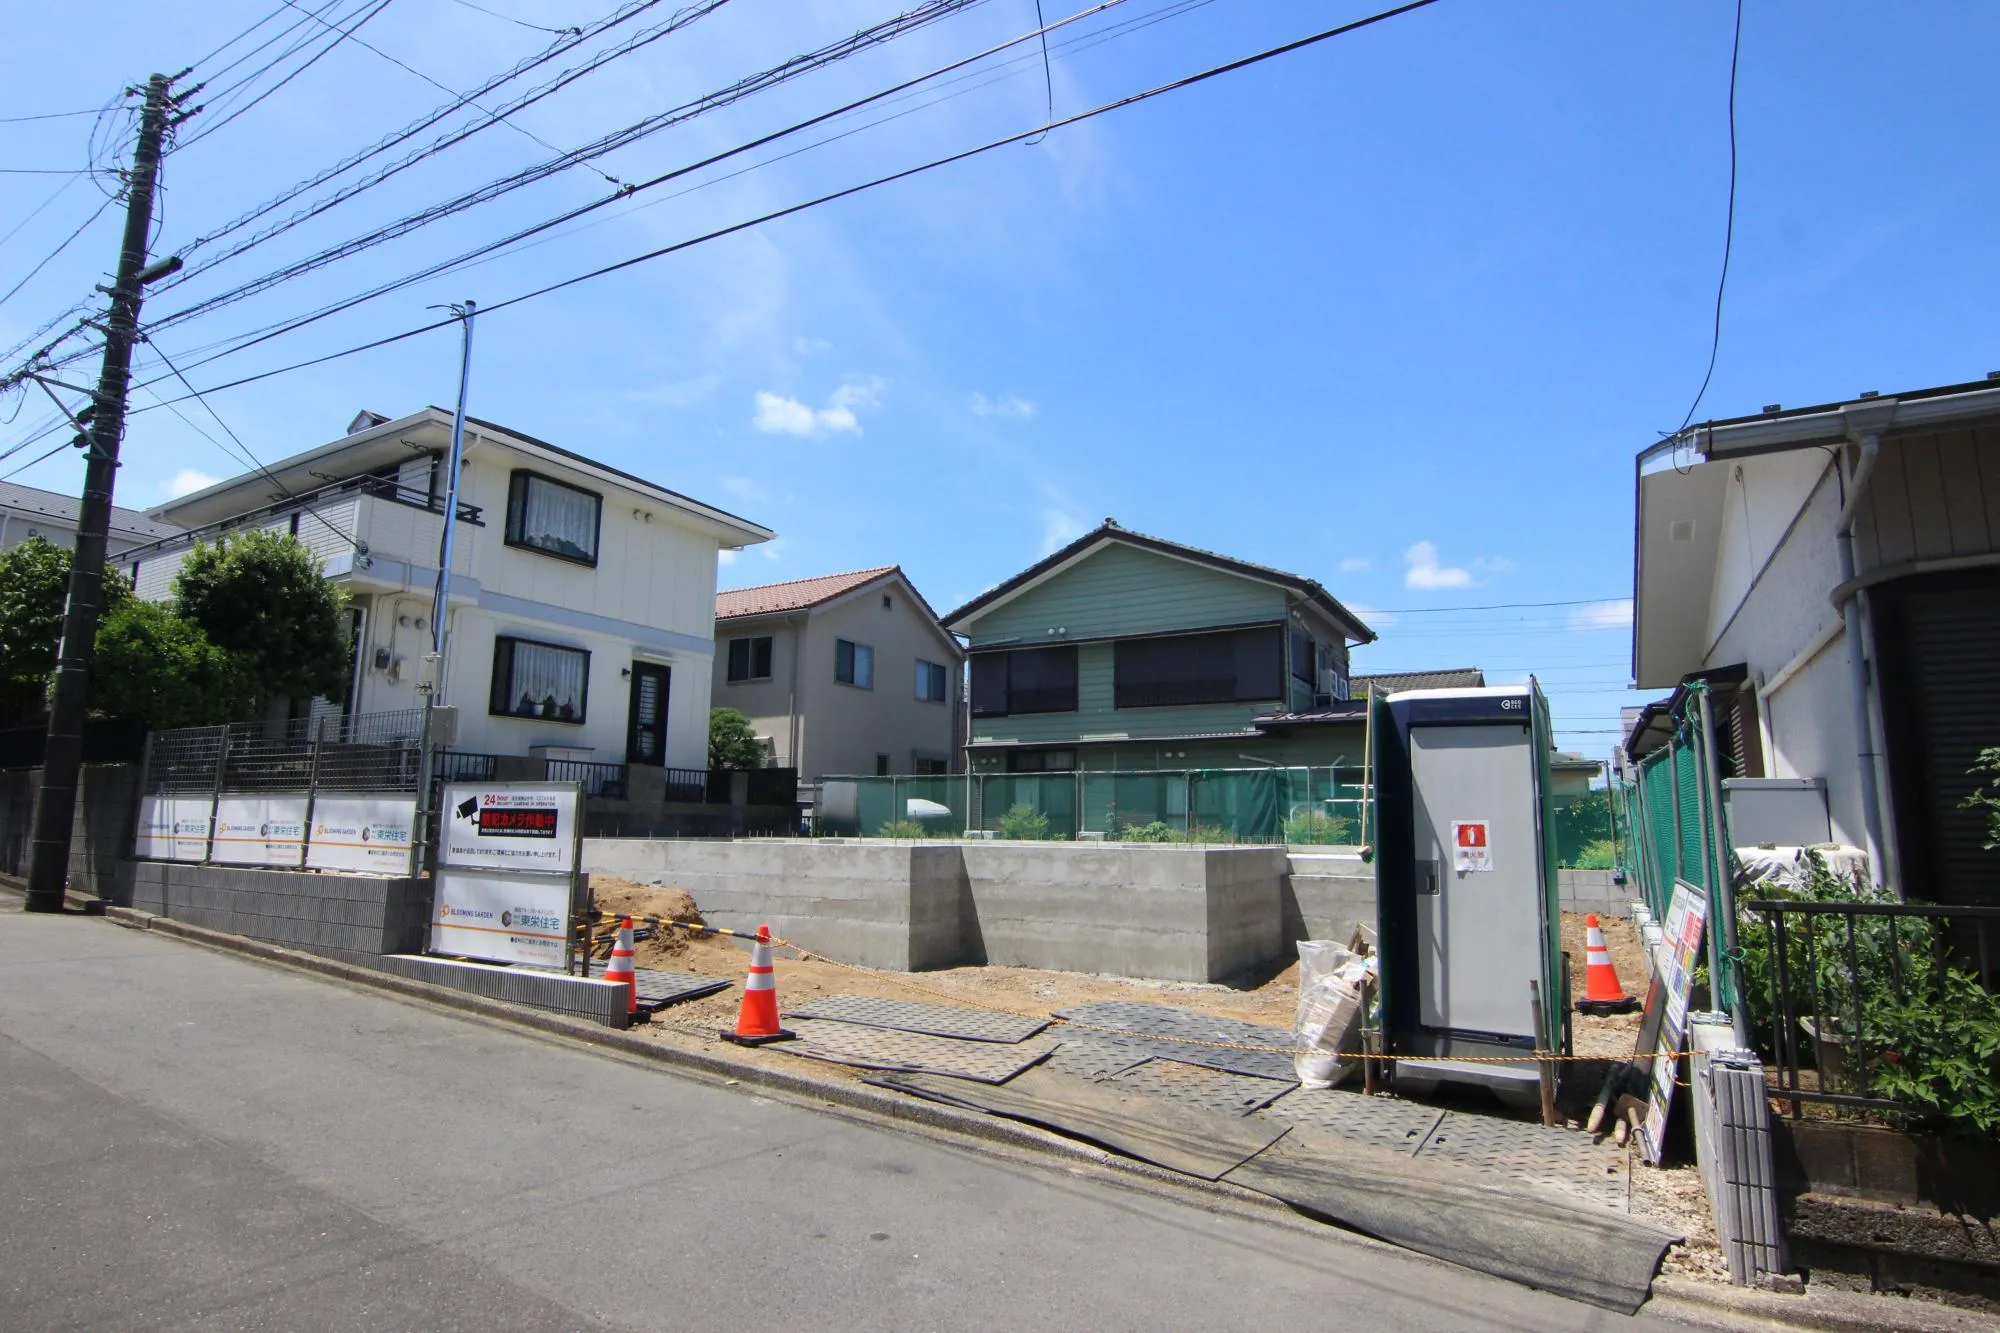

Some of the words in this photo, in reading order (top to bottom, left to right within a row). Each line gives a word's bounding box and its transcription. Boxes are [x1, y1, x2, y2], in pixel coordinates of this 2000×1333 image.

[484, 794, 496, 806] 24
[450, 907, 474, 917] BLOOMING
[474, 909, 494, 919] GARDEN
[520, 914, 560, 930] 東栄住宅
